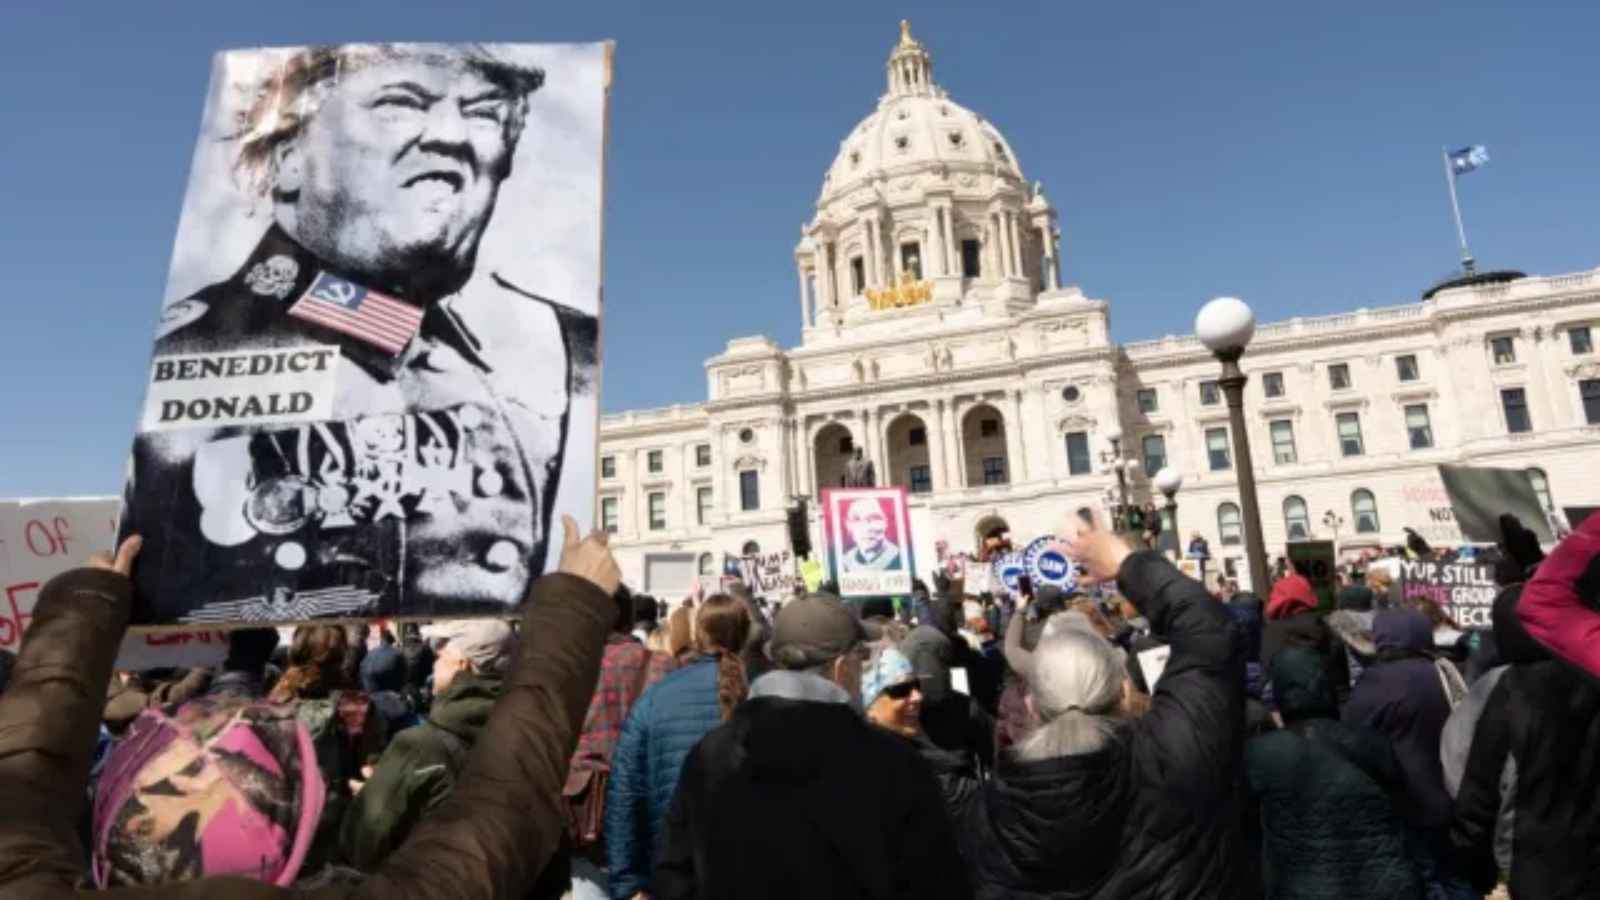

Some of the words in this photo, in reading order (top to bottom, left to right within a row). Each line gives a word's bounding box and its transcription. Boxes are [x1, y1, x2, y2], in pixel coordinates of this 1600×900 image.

[153, 351, 335, 383] BENEDICT
[159, 391, 314, 422] DONALD
[1400, 559, 1439, 585] YUP,
[1442, 564, 1495, 586] STILL
[1452, 587, 1496, 605] GROUP
